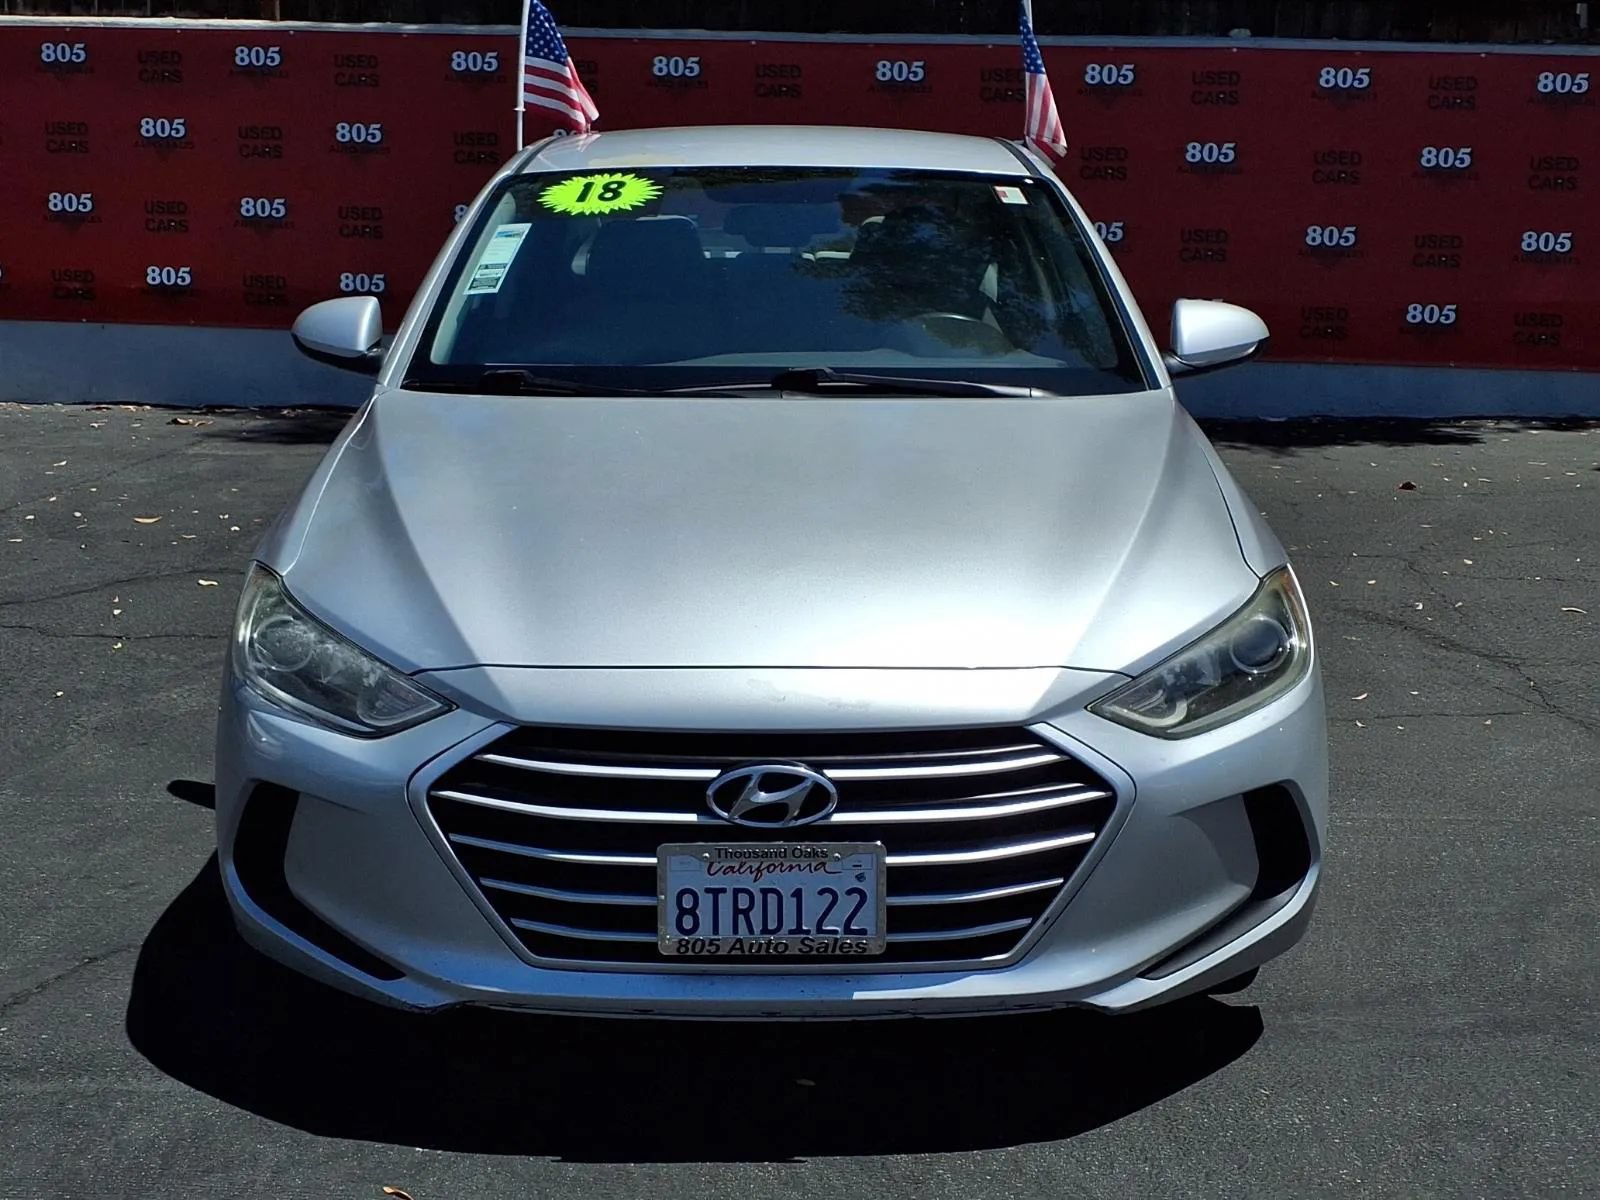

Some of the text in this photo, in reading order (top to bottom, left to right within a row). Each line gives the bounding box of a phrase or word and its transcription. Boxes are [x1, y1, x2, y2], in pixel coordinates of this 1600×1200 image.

[41, 43, 86, 63] 805
[138, 51, 182, 65] USED
[235, 46, 281, 66] 805
[334, 54, 378, 68] USED
[452, 51, 498, 71] 805
[653, 56, 699, 77] 805
[139, 69, 183, 83] CARS
[756, 64, 801, 79] USED
[876, 60, 924, 81] 805
[1085, 63, 1134, 84] 805
[1192, 70, 1240, 86] USED
[1319, 67, 1370, 88] 805
[334, 73, 380, 87] CARS
[1429, 75, 1478, 91] USED
[1537, 71, 1589, 93] 805
[755, 84, 801, 98] CARS
[979, 87, 1025, 102] CARS
[1191, 91, 1239, 106] CARS
[1428, 95, 1475, 110] CARS
[45, 122, 88, 135] USED
[140, 117, 185, 138] 805
[238, 126, 282, 140] USED
[336, 122, 382, 143] 805
[46, 140, 89, 153] CARS
[454, 132, 498, 146] USED
[239, 145, 283, 158] CARS
[454, 150, 499, 164] CARS
[1081, 147, 1128, 161] USED
[1185, 142, 1235, 163] 805
[1314, 151, 1361, 166] USED
[1421, 147, 1472, 168] 805
[1530, 156, 1579, 171] USED
[1080, 166, 1127, 181] CARS
[1312, 170, 1360, 185] CARS
[1528, 175, 1576, 191] CARS
[575, 180, 627, 203] 18
[48, 192, 92, 212] 805
[144, 201, 188, 214] USED
[240, 197, 285, 217] 805
[339, 207, 383, 221] USED
[145, 219, 189, 232] CARS
[339, 225, 383, 239] CARS
[1094, 221, 1124, 242] 05
[1181, 229, 1228, 243] USED
[1305, 226, 1356, 246] 805
[1414, 234, 1463, 249] USED
[1521, 231, 1572, 252] 805
[1179, 248, 1226, 262] CARS
[1413, 254, 1461, 269] CARS
[51, 269, 95, 283] USED
[146, 266, 191, 286] 805
[243, 275, 286, 289] USED
[340, 272, 385, 292] 805
[1301, 307, 1348, 322] USED
[1406, 303, 1457, 324] 805
[1513, 312, 1563, 327] USED
[715, 847, 829, 859] Thousand Oaks
[707, 860, 843, 883] California
[675, 887, 868, 936] 8TRD122
[676, 936, 868, 954] 805 Auto Sales
